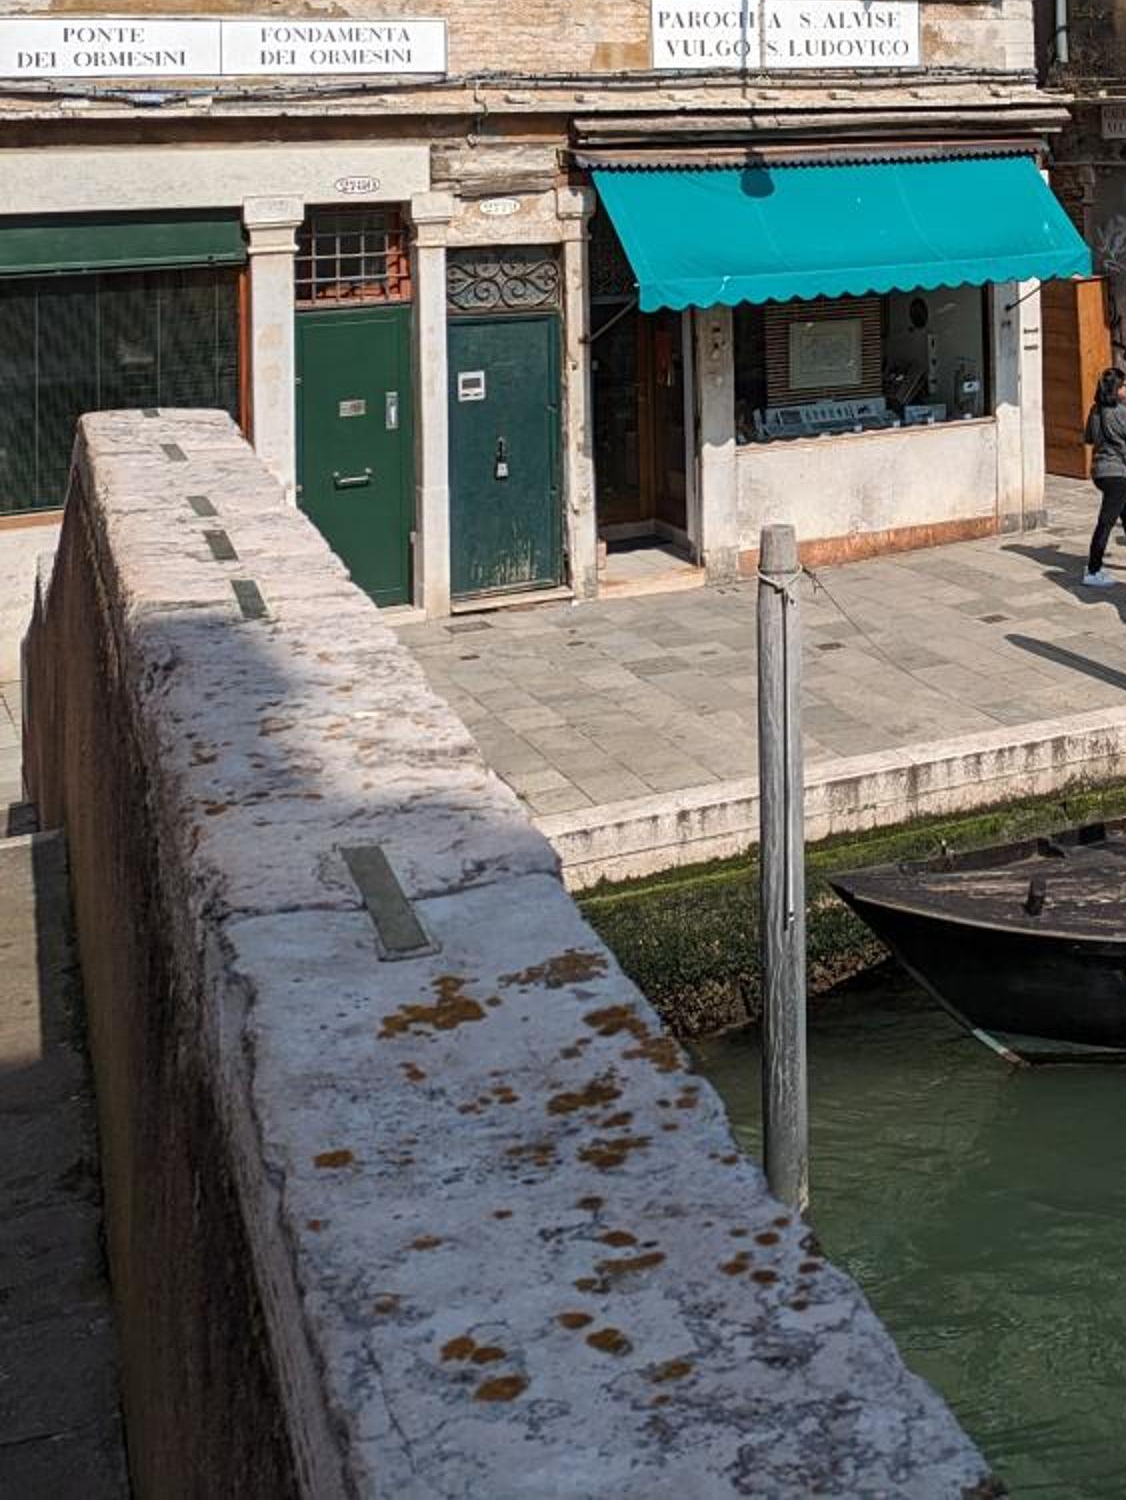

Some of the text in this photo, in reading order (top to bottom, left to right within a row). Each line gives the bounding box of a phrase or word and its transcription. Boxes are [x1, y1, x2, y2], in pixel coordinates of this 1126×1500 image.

[658, 11, 902, 29] PAROCHA S. ALVISE
[63, 27, 145, 43] PONTE
[261, 27, 411, 44] FONDAMENTA
[261, 49, 412, 65] DEI ORMESINI
[665, 40, 910, 57] VULGO S. LUDOVICO
[17, 51, 186, 68] DEI ORMESINI
